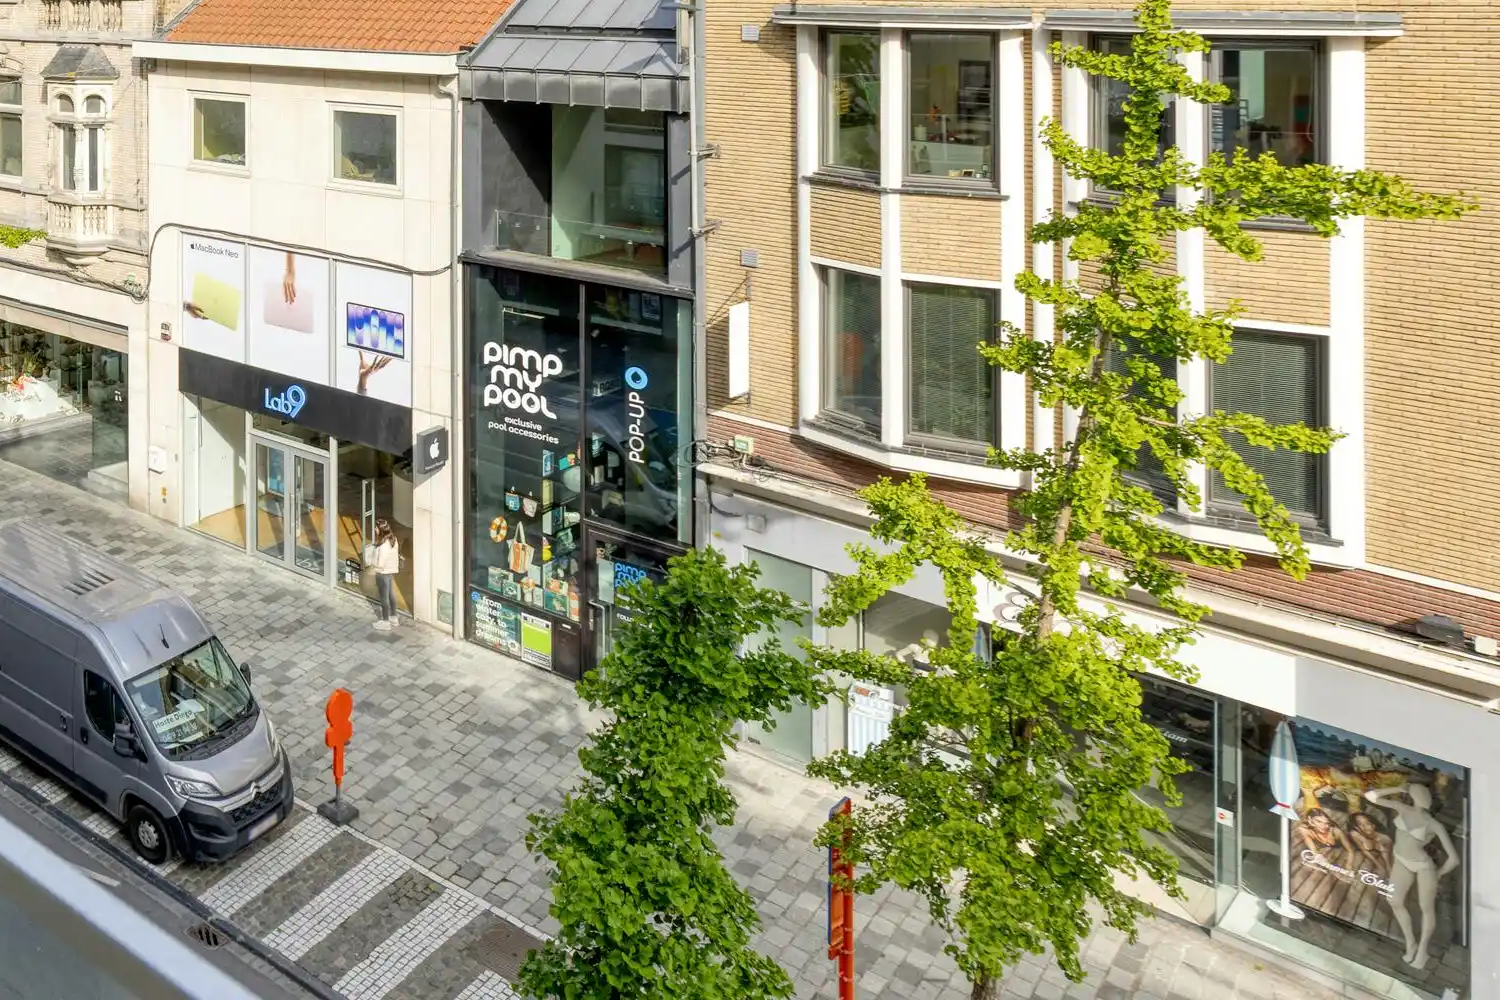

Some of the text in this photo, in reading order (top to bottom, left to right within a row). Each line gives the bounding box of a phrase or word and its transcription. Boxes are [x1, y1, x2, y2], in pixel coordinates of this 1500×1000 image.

[195, 243, 239, 258] MacBook Neo
[484, 341, 563, 377] pimp
[491, 364, 543, 392] my
[265, 384, 306, 418] Lab9
[484, 384, 557, 419] pool
[488, 421, 559, 444] pool accessories
[504, 416, 542, 431] exclusive
[628, 391, 645, 463] POP-UP
